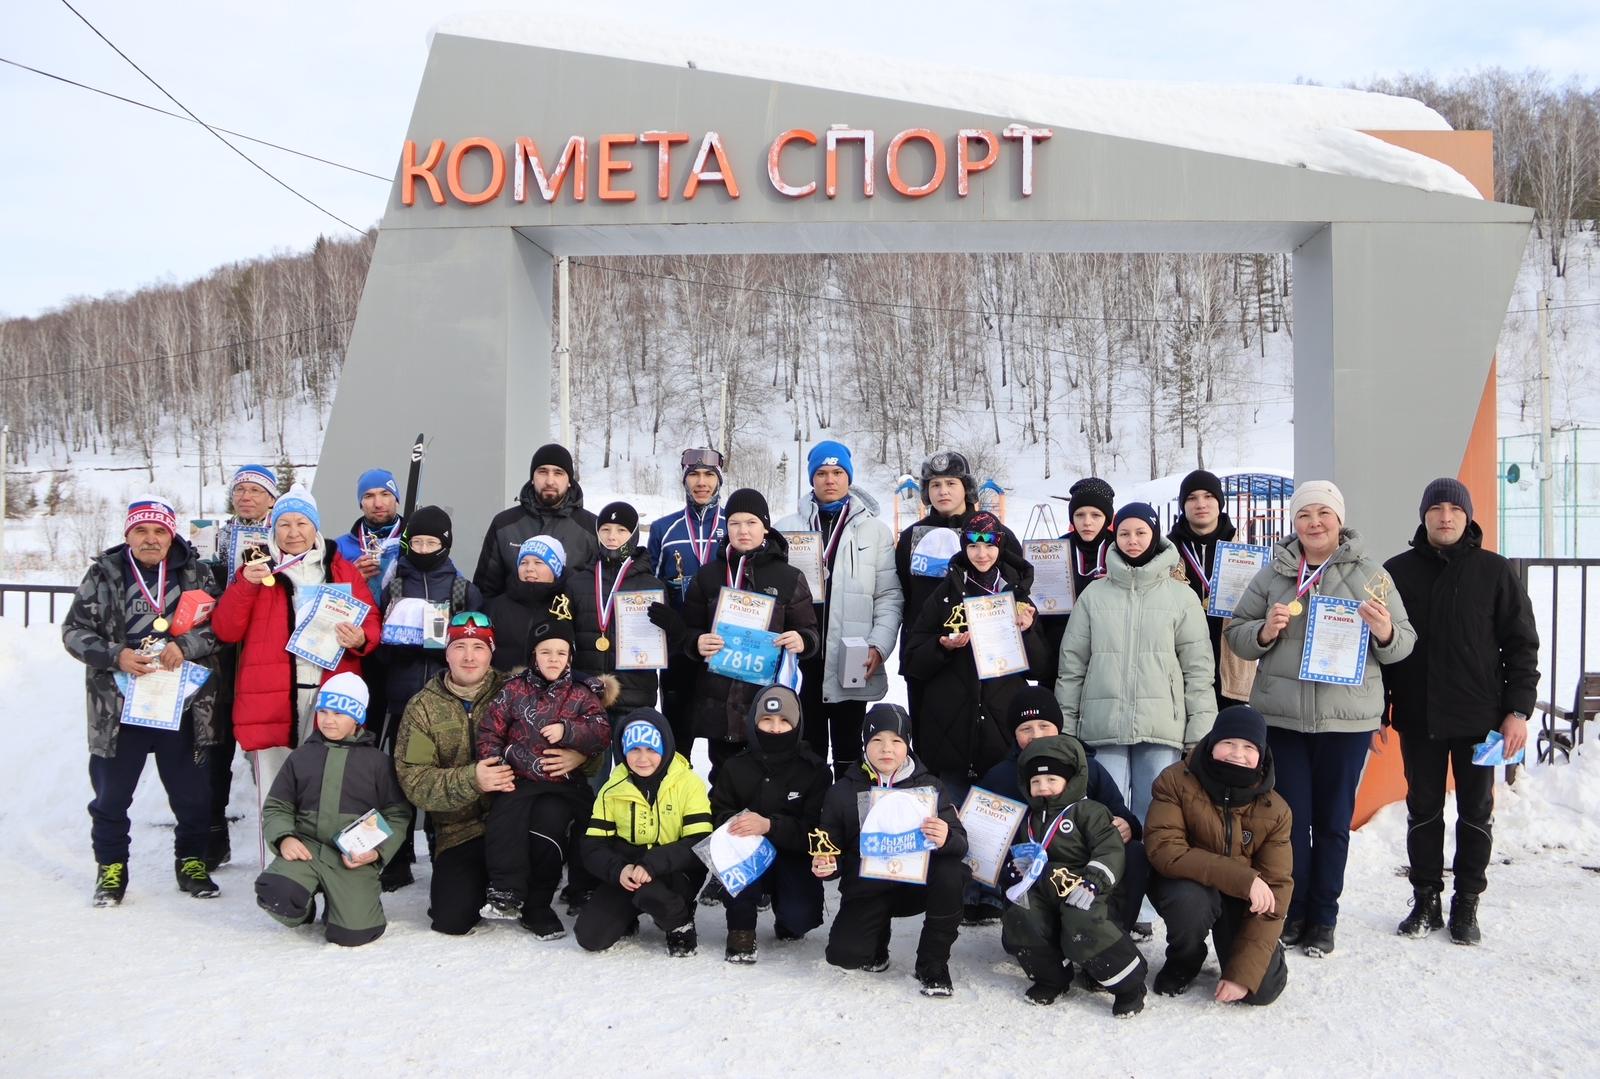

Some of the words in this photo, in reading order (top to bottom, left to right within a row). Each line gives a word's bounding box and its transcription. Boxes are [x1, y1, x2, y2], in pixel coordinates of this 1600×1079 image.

[401, 130, 740, 206] КОМЕТА
[766, 126, 1053, 200] СПОРТ
[324, 603, 350, 617] ГРАМОТА
[729, 603, 760, 616] ГРАМОТА
[975, 609, 1006, 619] ГРАМОТА
[1323, 614, 1355, 623] ГРАМОТА
[722, 648, 765, 673] 7815
[325, 693, 365, 719] 2026
[624, 725, 662, 749] 2026
[975, 805, 1008, 822] ГРАМОТА
[880, 839, 917, 854] РОССИИ
[881, 832, 916, 847] ЛЫЖНЯ
